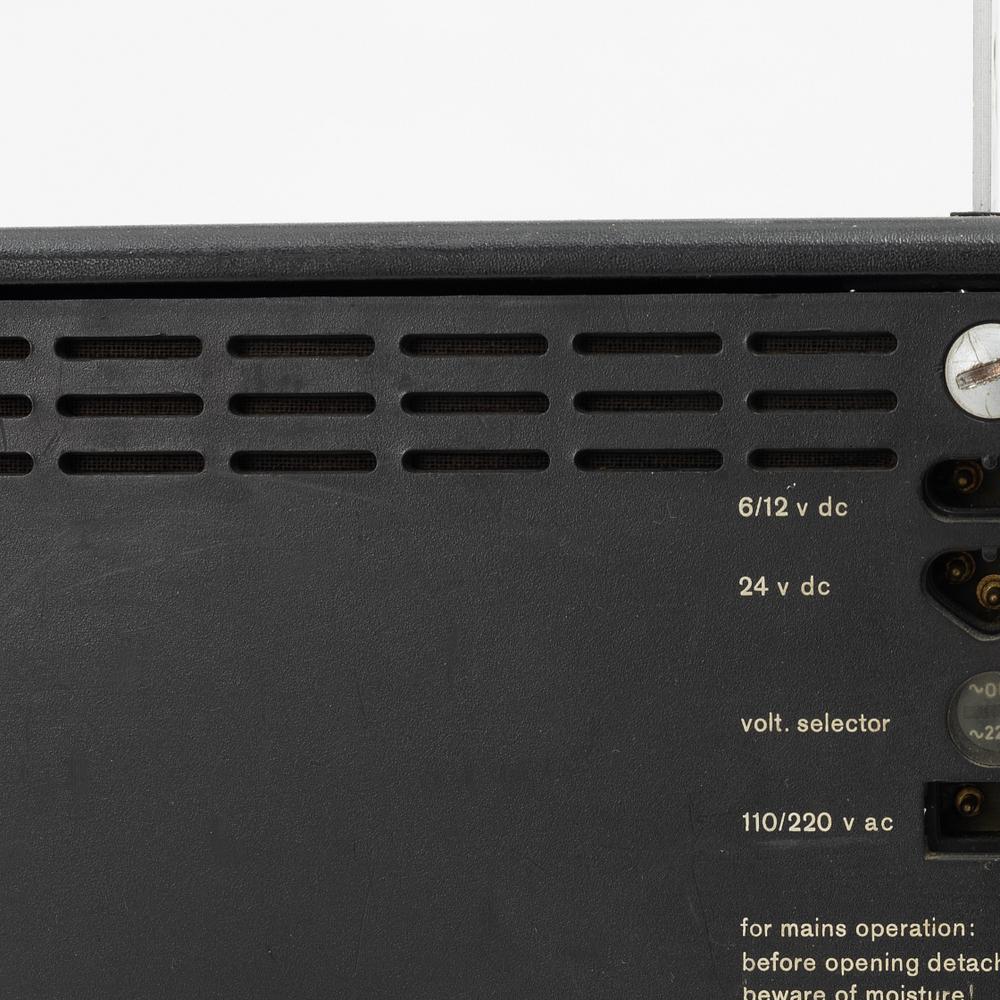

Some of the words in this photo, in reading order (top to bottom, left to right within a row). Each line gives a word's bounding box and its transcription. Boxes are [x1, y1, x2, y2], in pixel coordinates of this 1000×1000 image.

[738, 496, 789, 518] 6/12
[796, 501, 809, 517] v
[817, 495, 848, 518] dc
[738, 575, 770, 597] 24
[776, 581, 789, 597] v
[799, 574, 831, 597] dc
[740, 711, 789, 733] volt.
[796, 712, 891, 733] selector
[741, 811, 833, 833] 110/220
[842, 816, 855, 832] v
[864, 816, 894, 833] ac
[740, 916, 773, 938] for
[780, 917, 847, 938] mains
[855, 917, 976, 942] operation:
[742, 951, 817, 973] before
[825, 952, 919, 977] opening
